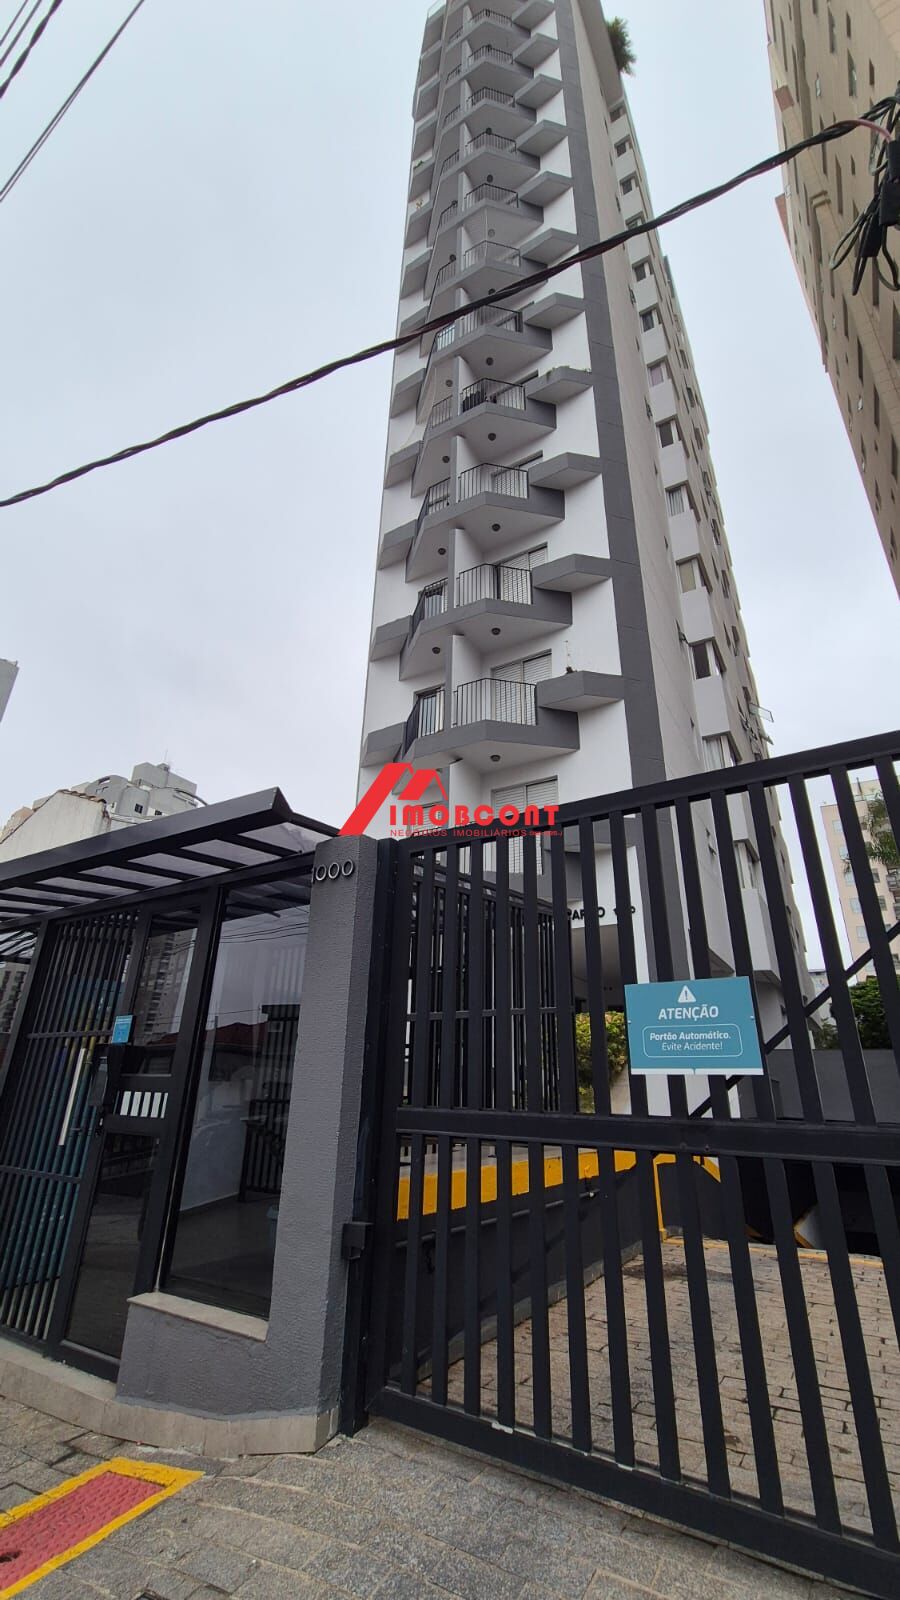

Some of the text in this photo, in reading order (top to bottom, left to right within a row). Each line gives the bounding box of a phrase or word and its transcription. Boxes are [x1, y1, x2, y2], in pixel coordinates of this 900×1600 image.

[658, 1004, 719, 1021] ATENÇÃO
[649, 1030, 731, 1041] Portão Automático.
[661, 1041, 723, 1051] Evite Acidente!
